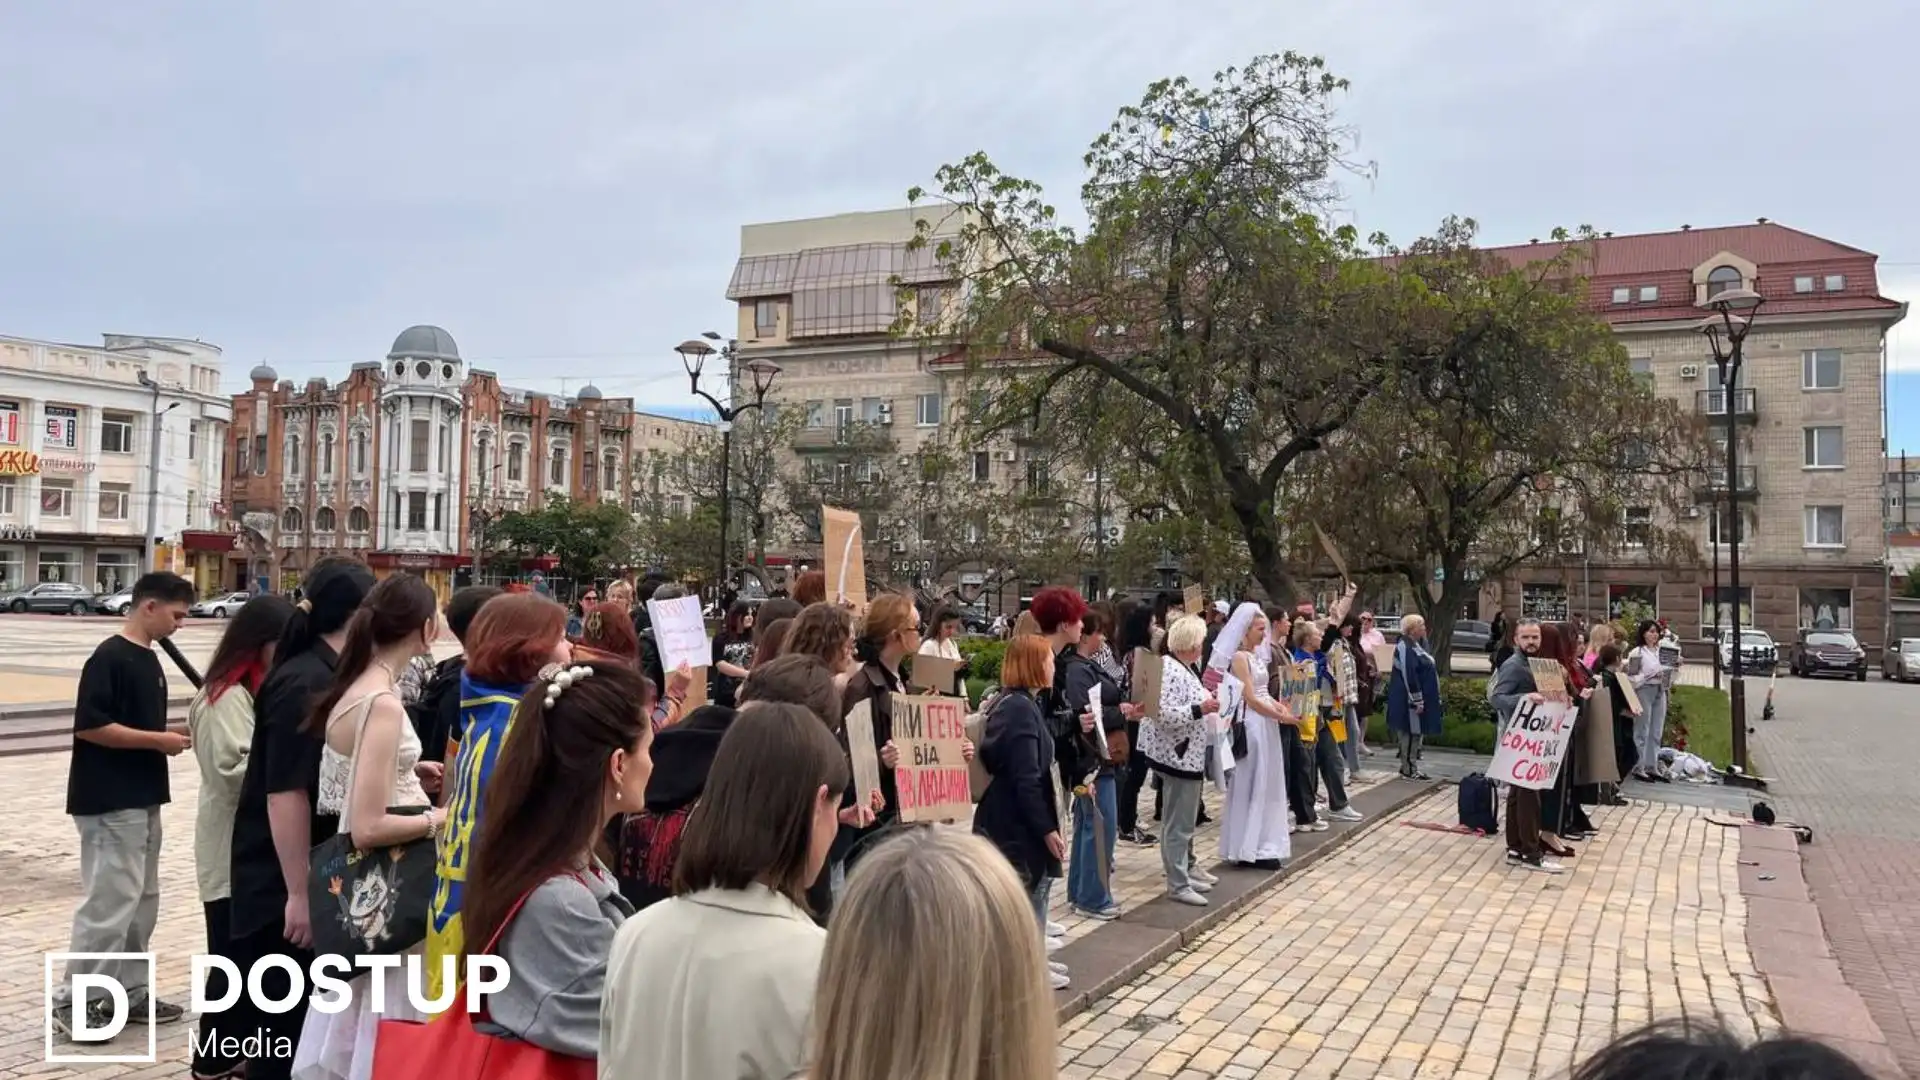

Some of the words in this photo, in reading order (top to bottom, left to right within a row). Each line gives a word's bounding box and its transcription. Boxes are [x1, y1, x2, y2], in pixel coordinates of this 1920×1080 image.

[39, 457, 96, 473] СУПЕРМАРКЕТ
[927, 703, 963, 740] ГЕТЬ
[918, 767, 969, 807] ЛЮДИНИ
